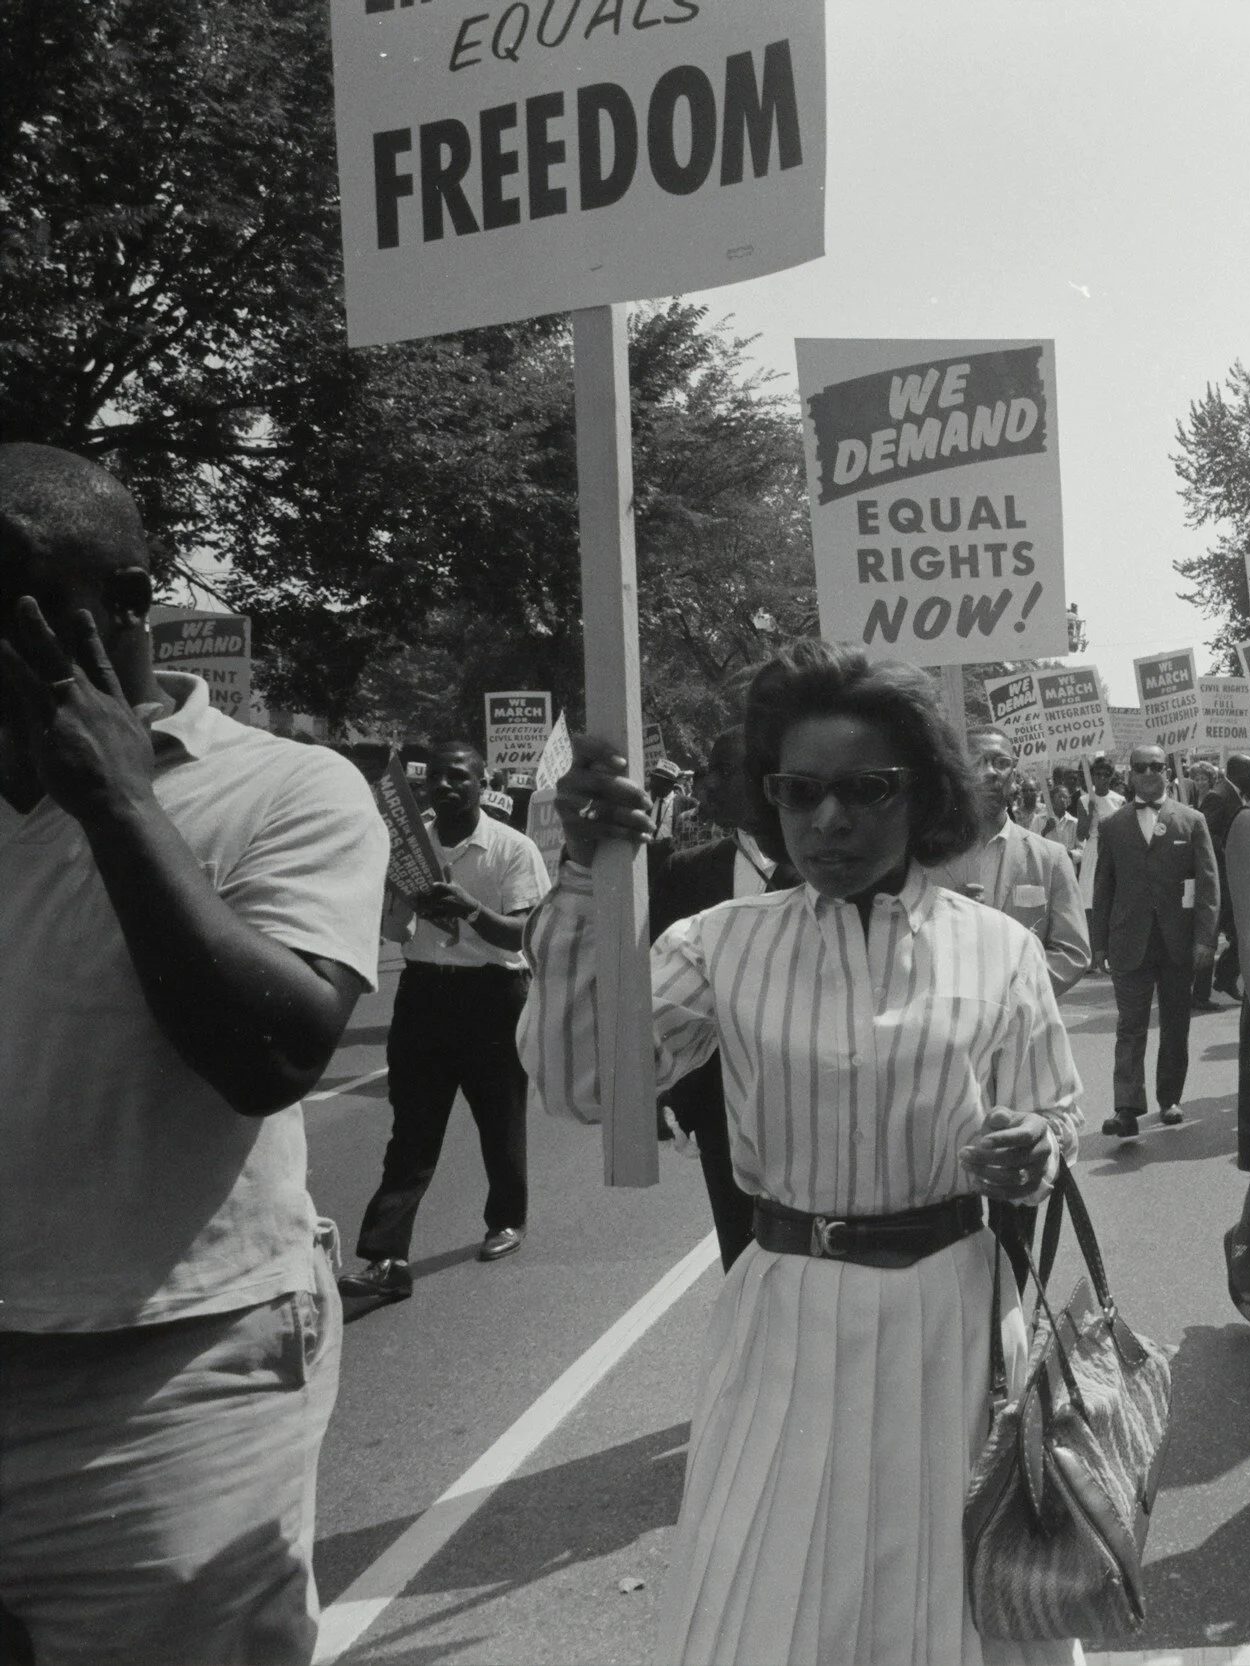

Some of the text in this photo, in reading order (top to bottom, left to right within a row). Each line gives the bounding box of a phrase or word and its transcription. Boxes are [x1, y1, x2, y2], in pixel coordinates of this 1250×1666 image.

[373, 39, 803, 249] FREEDOM
[889, 363, 971, 420] WE
[833, 397, 1038, 485] DEMAND
[857, 495, 1027, 535] EQUAL
[857, 541, 1035, 584] RIGHTS
[862, 581, 1043, 645] NOW!
[182, 620, 216, 638] WE
[159, 636, 242, 659] DEMAND
[1159, 661, 1173, 671] WE
[1009, 678, 1031, 696] WE
[1058, 675, 1075, 685] WE
[1146, 669, 1188, 689] MARCH
[1045, 683, 1093, 699] MARCH
[1161, 686, 1177, 694] FOR
[1200, 684, 1220, 692] CIVIL
[1223, 684, 1249, 693] RIGHTS
[494, 707, 542, 717] MARCH
[997, 691, 1035, 717] DEMA
[1045, 704, 1102, 721] INTEGRATED
[1145, 700, 1169, 715] FIRST
[1171, 694, 1197, 708] CLASS
[1214, 700, 1234, 708] FULL
[1004, 712, 1040, 726] AN EN
[1048, 717, 1104, 735] SCHOOLS
[1145, 707, 1199, 728] CITIZENSHIP
[1009, 732, 1044, 744] RUTALIT
[1015, 723, 1043, 735] POLICE
[1156, 722, 1197, 746] NOW!
[1206, 726, 1247, 738] REEDOM
[1012, 741, 1047, 757] NOW
[1056, 729, 1104, 752] NOW!
[496, 750, 544, 763] NOW!
[516, 776, 535, 785] UA
[380, 774, 409, 827] MARCH
[407, 835, 435, 885] WASHINGT
[400, 853, 432, 895] FREEDO
